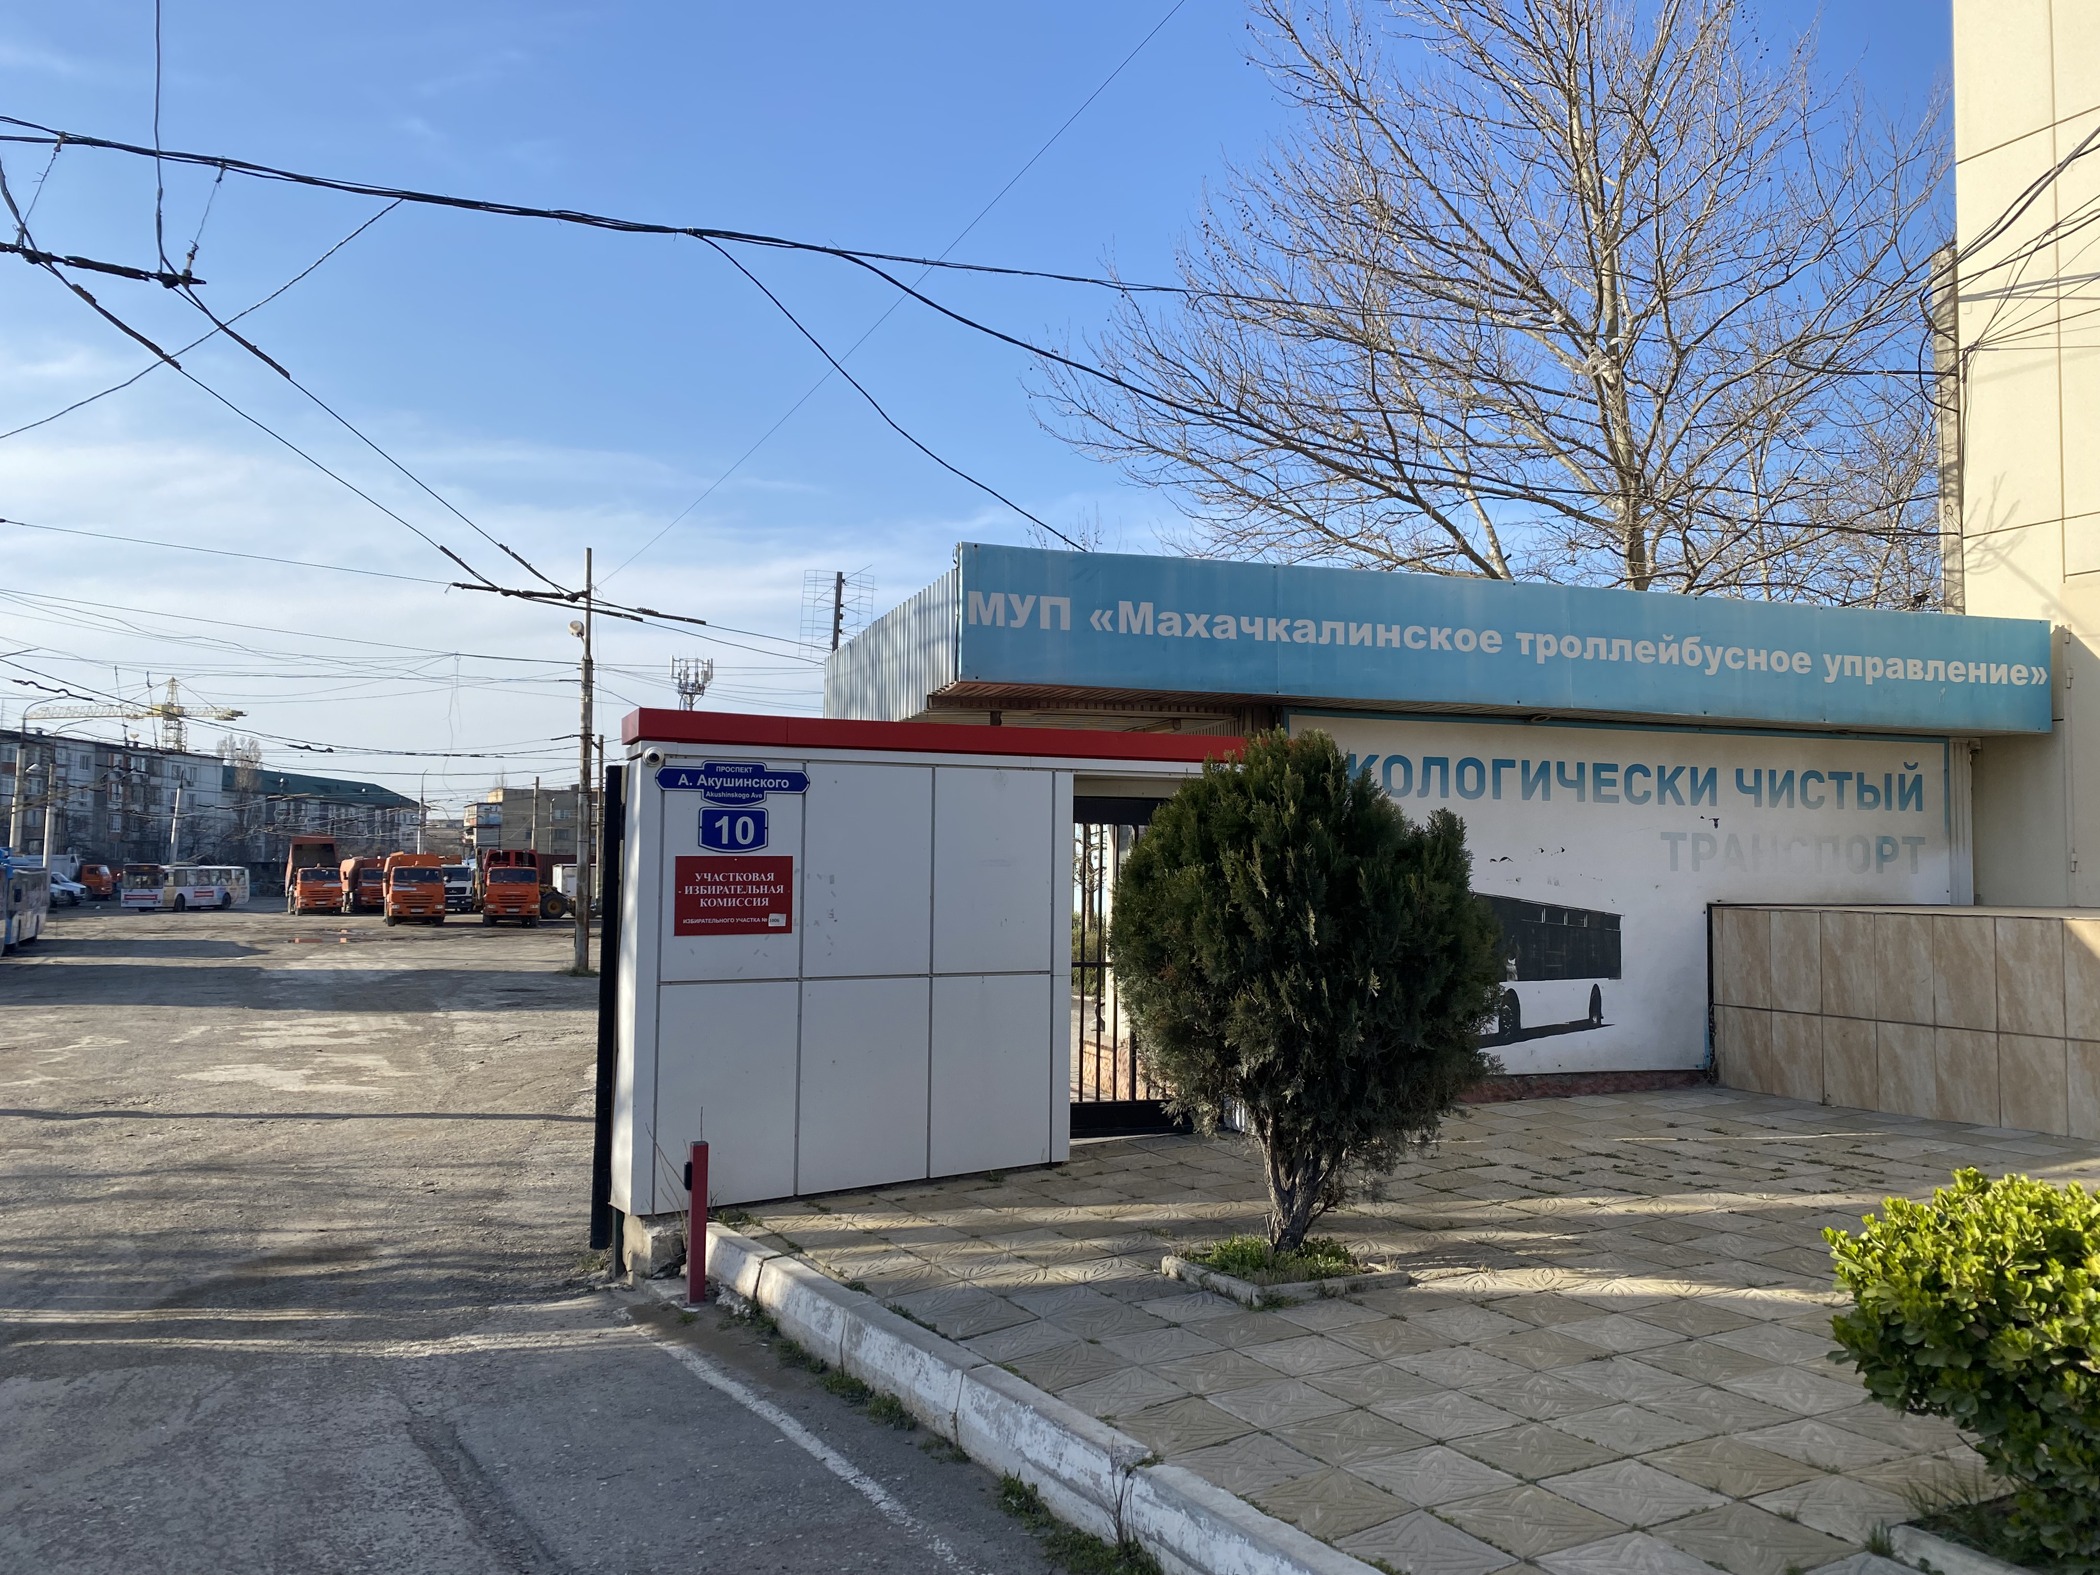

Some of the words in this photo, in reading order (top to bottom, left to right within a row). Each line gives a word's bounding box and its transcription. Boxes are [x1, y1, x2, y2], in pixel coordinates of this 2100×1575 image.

[967, 590, 1071, 631] МУП
[1089, 600, 1503, 654] «Махачкалинское
[1515, 630, 1812, 676] троллейбусное
[1823, 653, 2048, 686] управление»
[677, 773, 693, 786] А.
[696, 774, 789, 790] Акушинского
[1347, 753, 1718, 807] КОЛОГИЧЕСКИ
[1735, 761, 1923, 812] ЧИСТЫЙ
[705, 791, 750, 799] Akushinskogo
[714, 815, 755, 845] 10
[1660, 831, 1926, 875] ТРАНСПОРТ
[695, 872, 775, 882] УЧАСТКОВАЯ
[684, 885, 784, 895] ИЗБИРАТЕЛЬНАЯ
[700, 898, 769, 907] КОМИССИЯ
